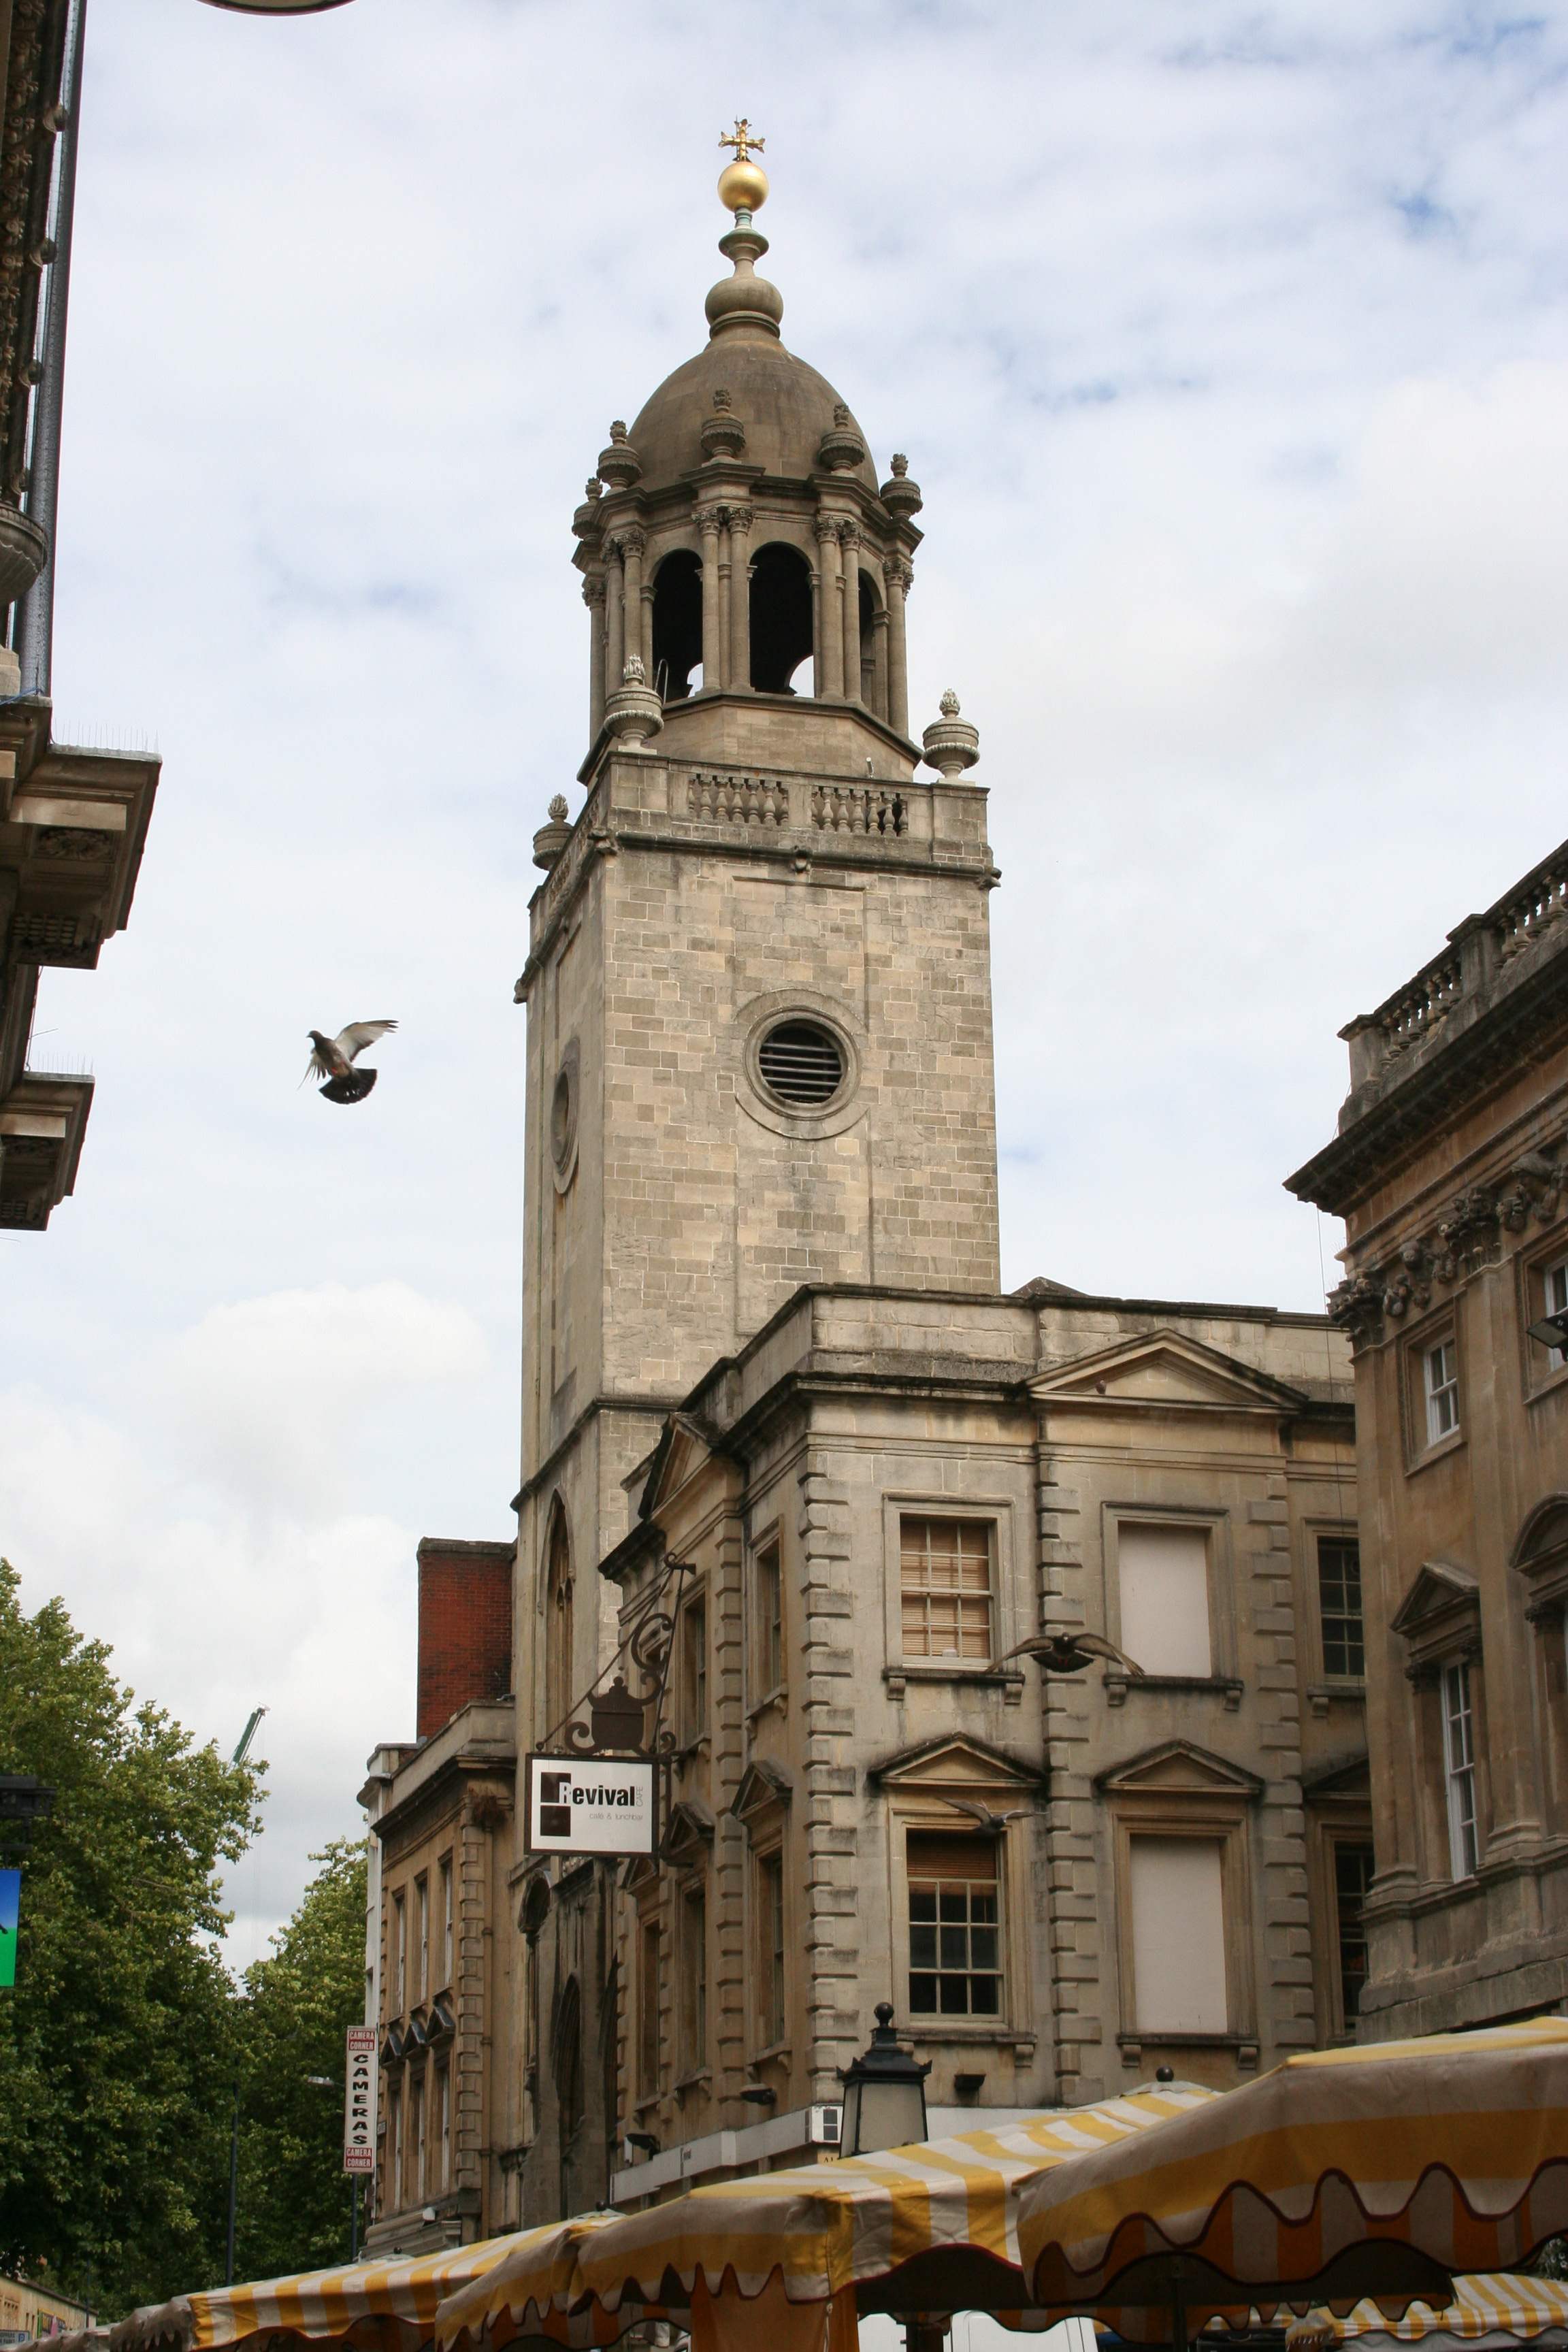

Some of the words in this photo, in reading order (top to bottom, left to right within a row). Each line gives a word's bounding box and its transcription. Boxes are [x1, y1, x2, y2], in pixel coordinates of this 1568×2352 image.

[559, 1782, 635, 1806] Revival
[615, 1813, 643, 1821] lunchbar
[350, 2031, 374, 2040] CAMERA
[350, 2041, 374, 2050] CORNER
[352, 2054, 369, 2144] CAMERAS
[347, 2148, 372, 2157] CAMERA
[347, 2158, 371, 2167] CORNER
